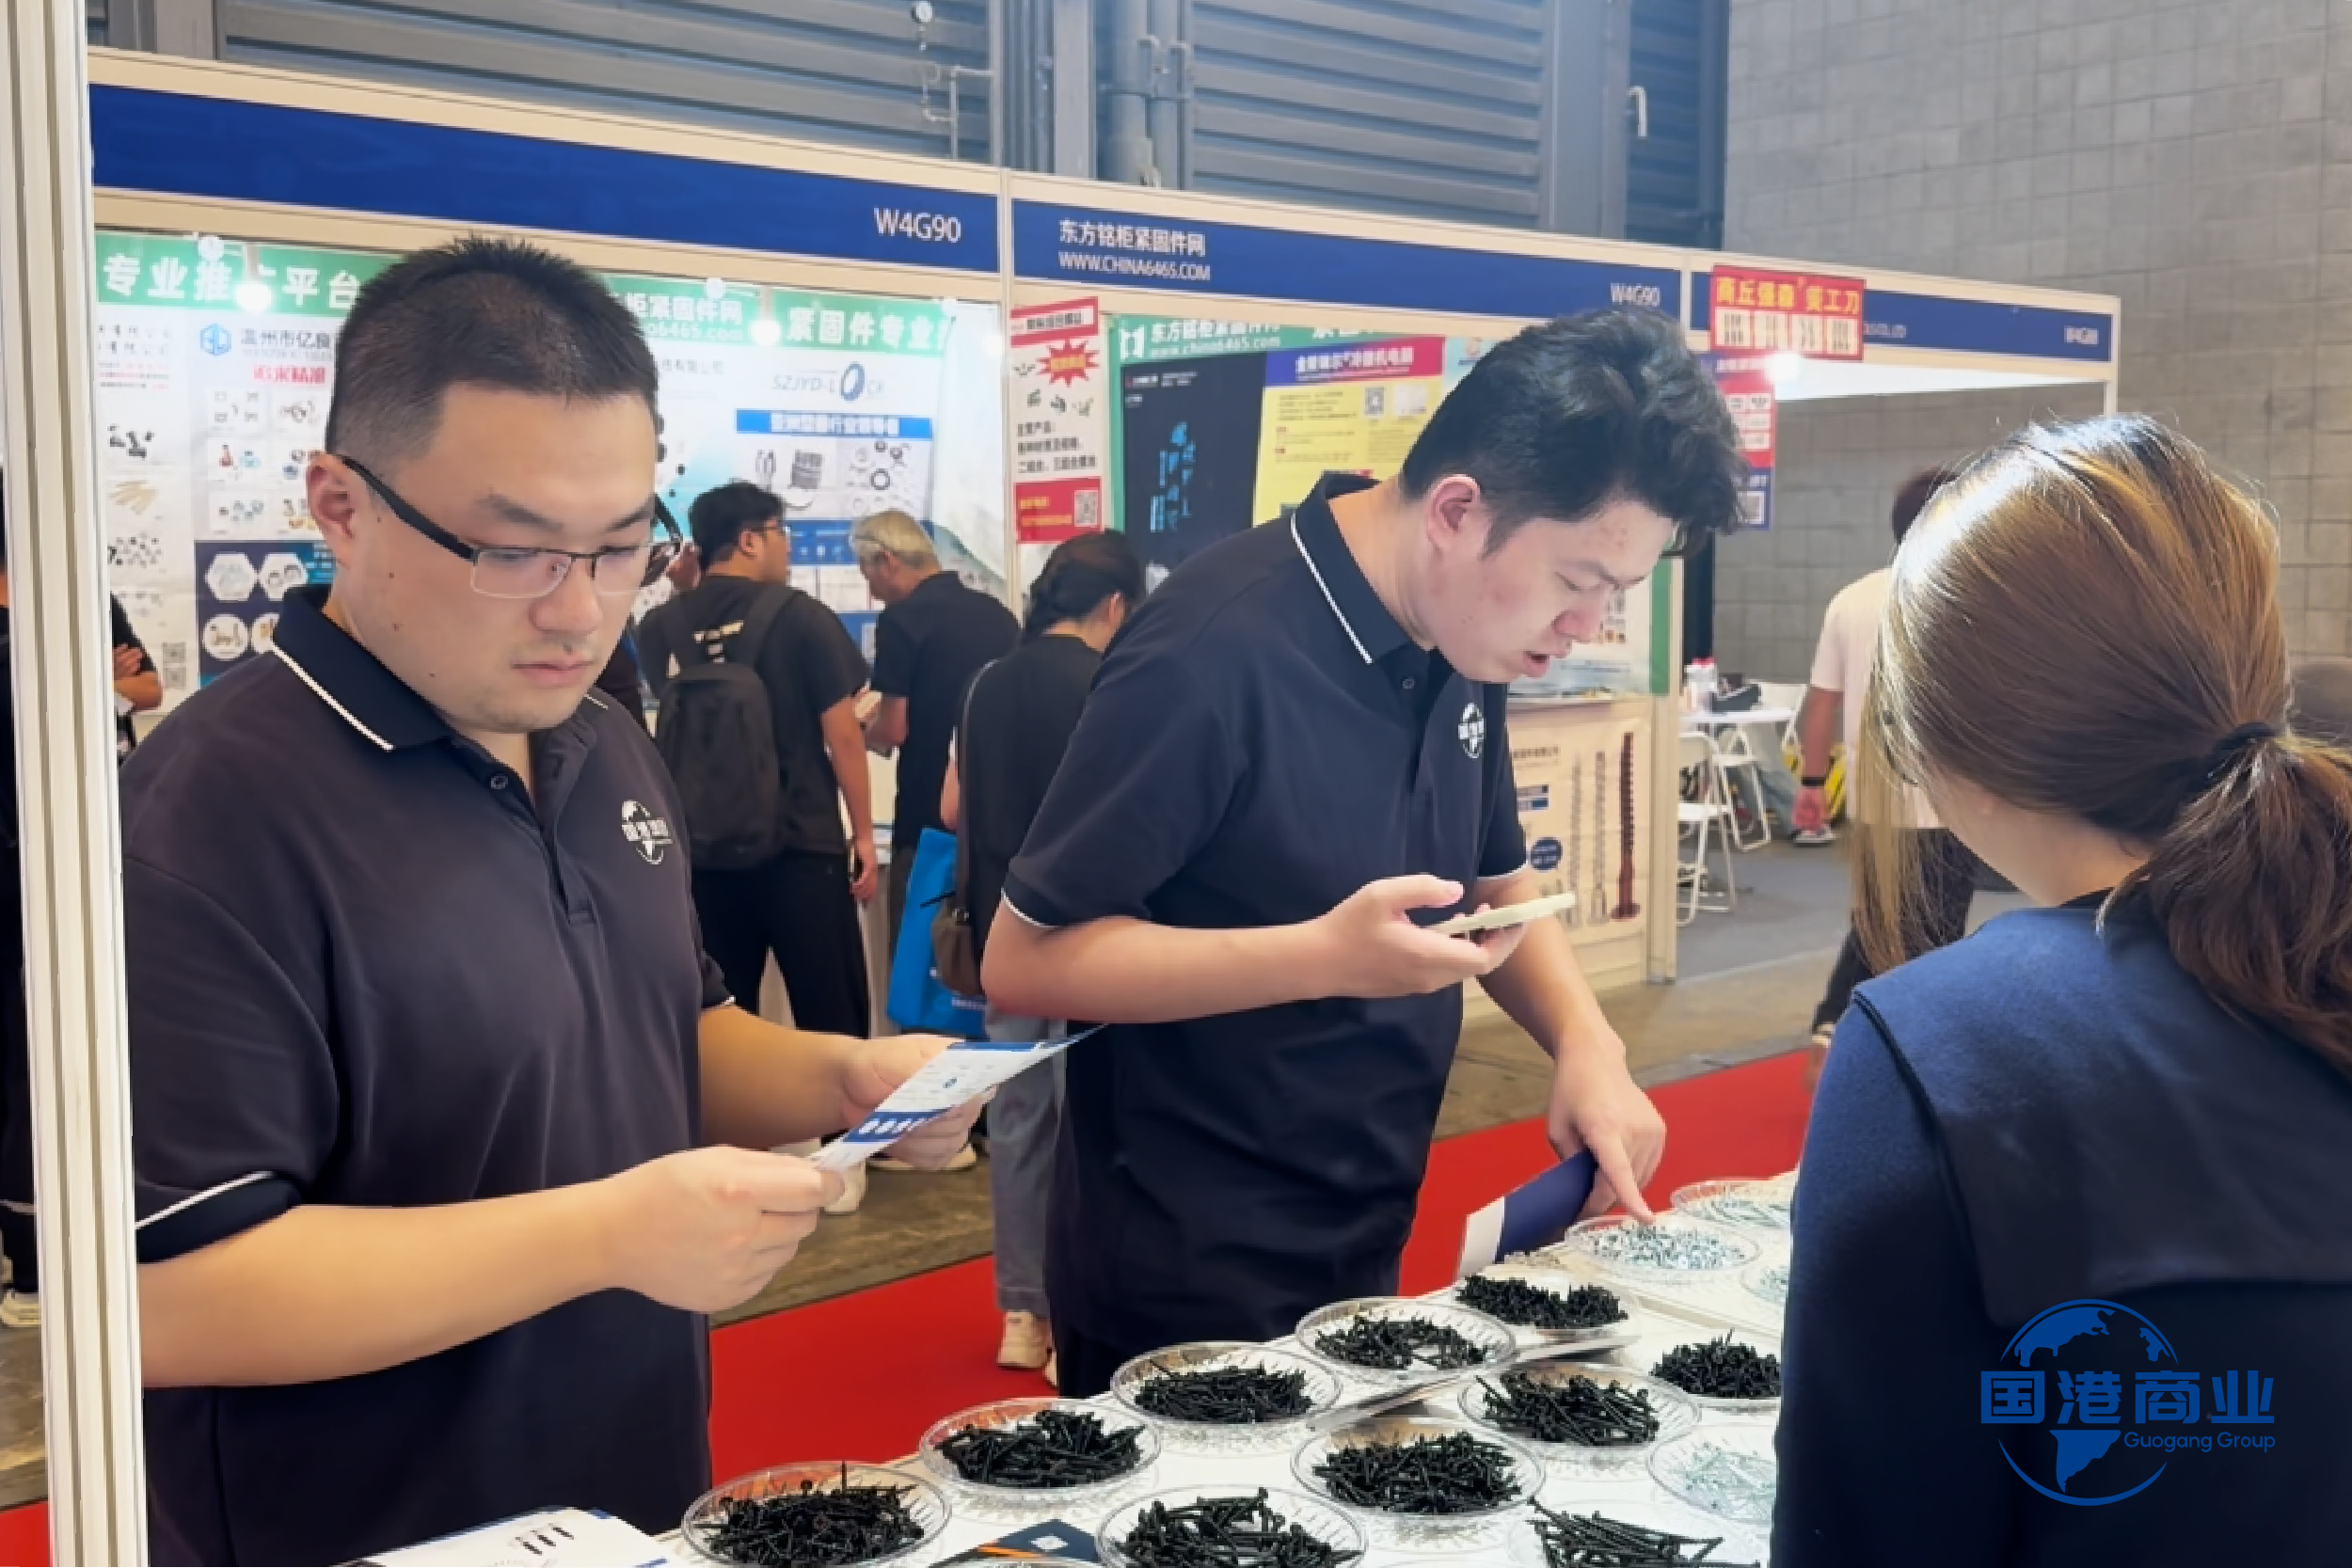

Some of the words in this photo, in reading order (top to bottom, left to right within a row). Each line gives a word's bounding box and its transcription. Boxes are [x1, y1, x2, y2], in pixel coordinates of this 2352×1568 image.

[873, 207, 961, 243] W4G90
[1058, 217, 1206, 257] 东方铭柜紧固件网
[103, 252, 360, 309] 专业推平台
[1058, 250, 1211, 280] WWW.CHINA6465.COM
[1611, 282, 1661, 308] W4G90
[787, 306, 946, 353] 紧固件专业
